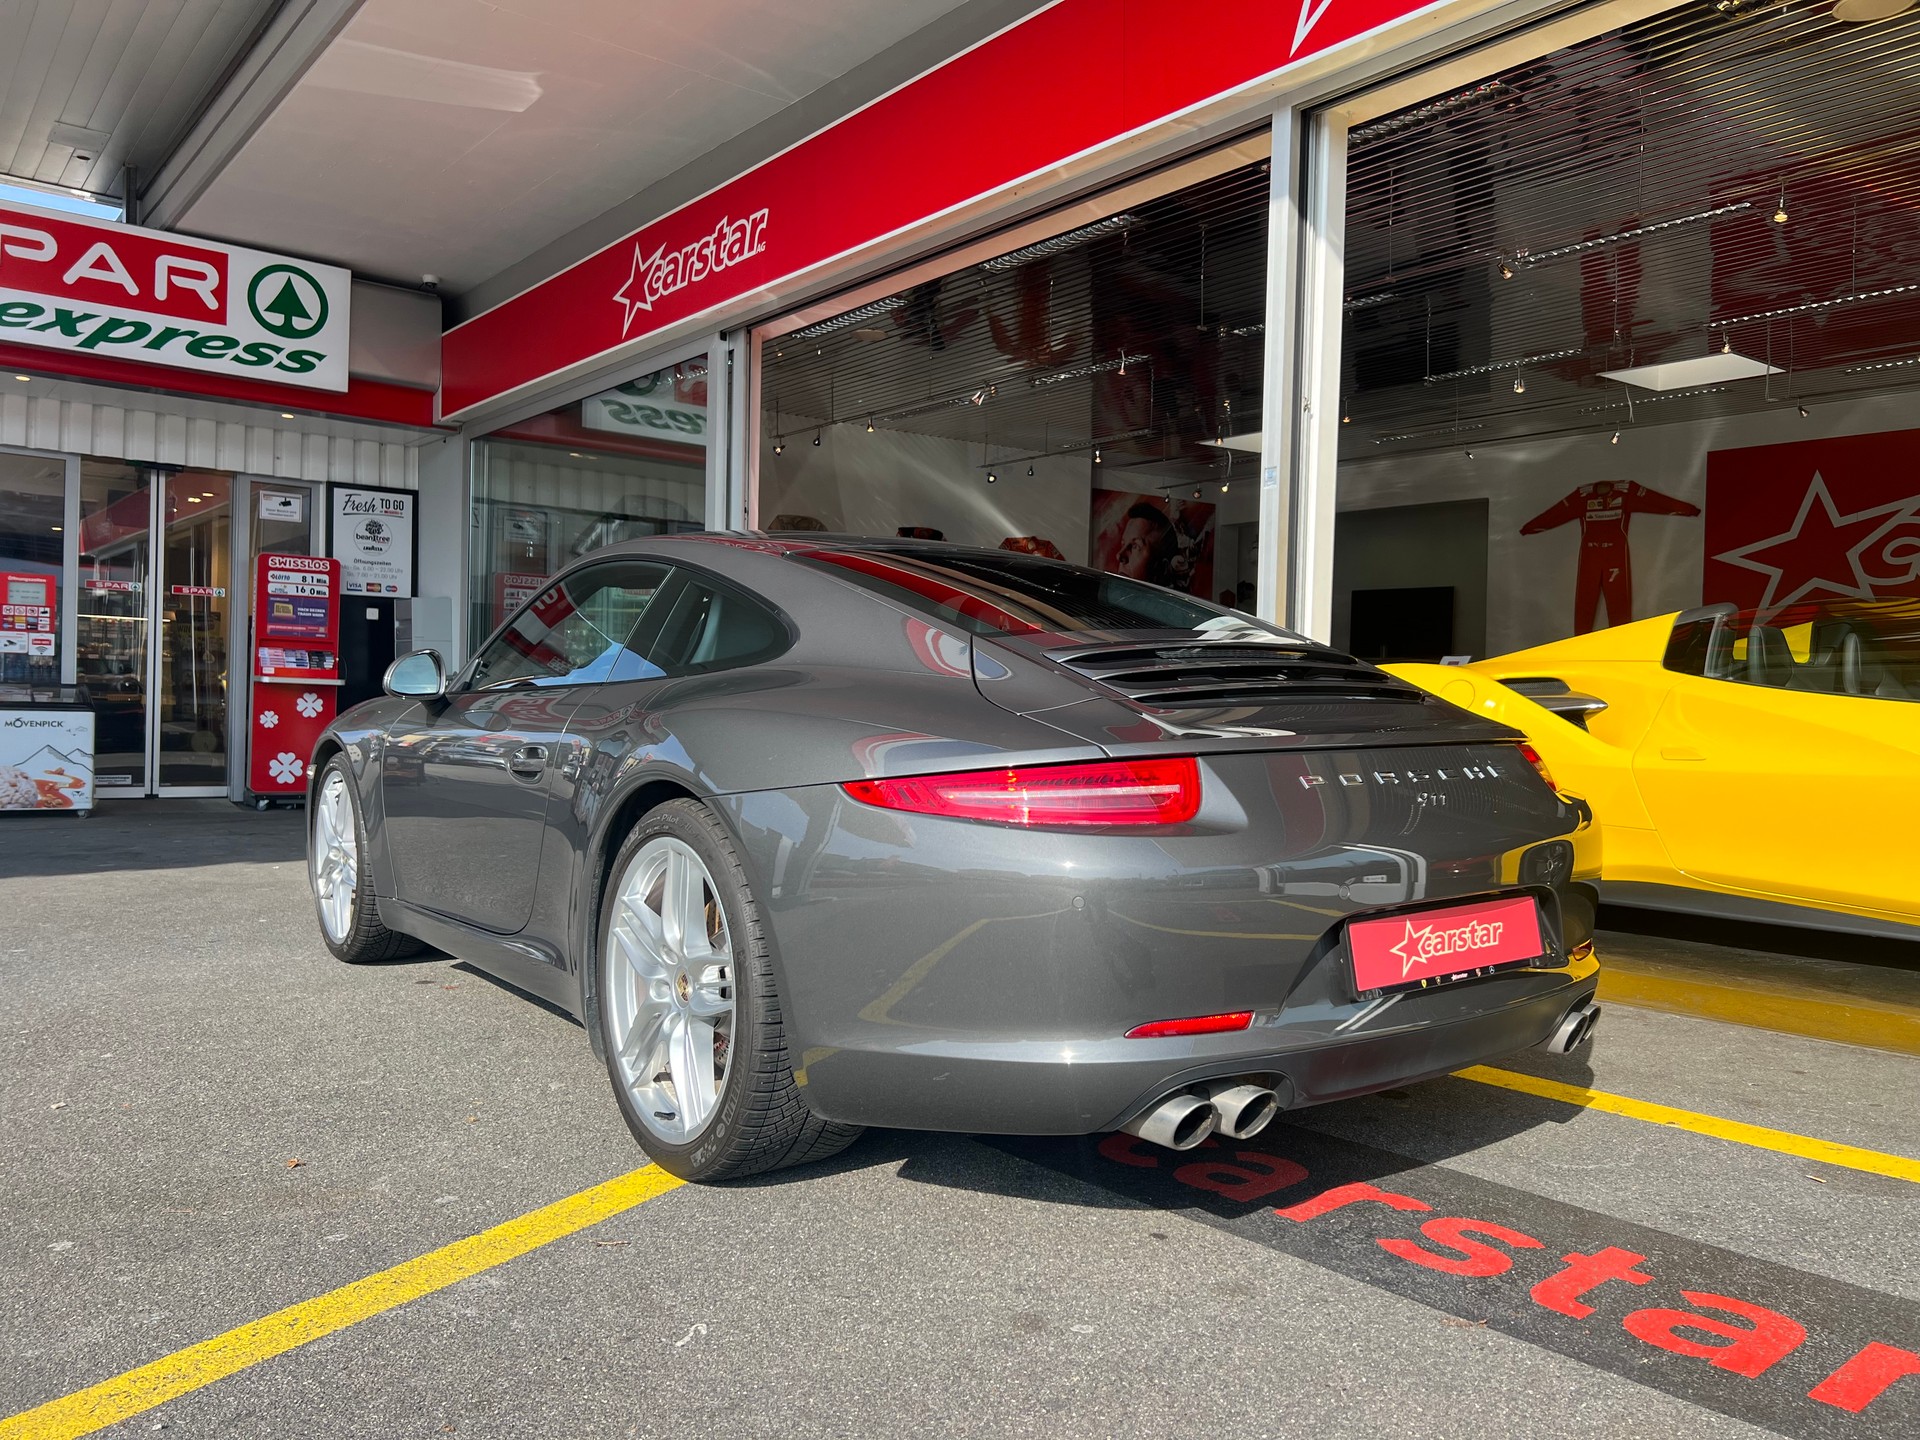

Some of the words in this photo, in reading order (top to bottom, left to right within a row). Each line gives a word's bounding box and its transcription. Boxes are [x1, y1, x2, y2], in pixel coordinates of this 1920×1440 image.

[645, 208, 769, 301] carstar
[757, 241, 766, 253] AG
[0, 223, 219, 311] PAR
[0, 301, 327, 374] express
[343, 494, 377, 512] Fresh
[380, 498, 390, 510] TO
[393, 500, 404, 511] GO
[269, 557, 329, 570] SWISSLOS
[353, 558, 392, 566] Öffnungszeiten
[1609, 568, 1619, 582] 7
[95, 582, 129, 590] SPAR
[182, 587, 213, 595] SPAR
[1299, 764, 1506, 790] PORSCHE
[1417, 791, 1447, 807] 911
[661, 813, 680, 825] Pilot
[1418, 920, 1503, 957] carstar
[1098, 1132, 1920, 1413] carstar
